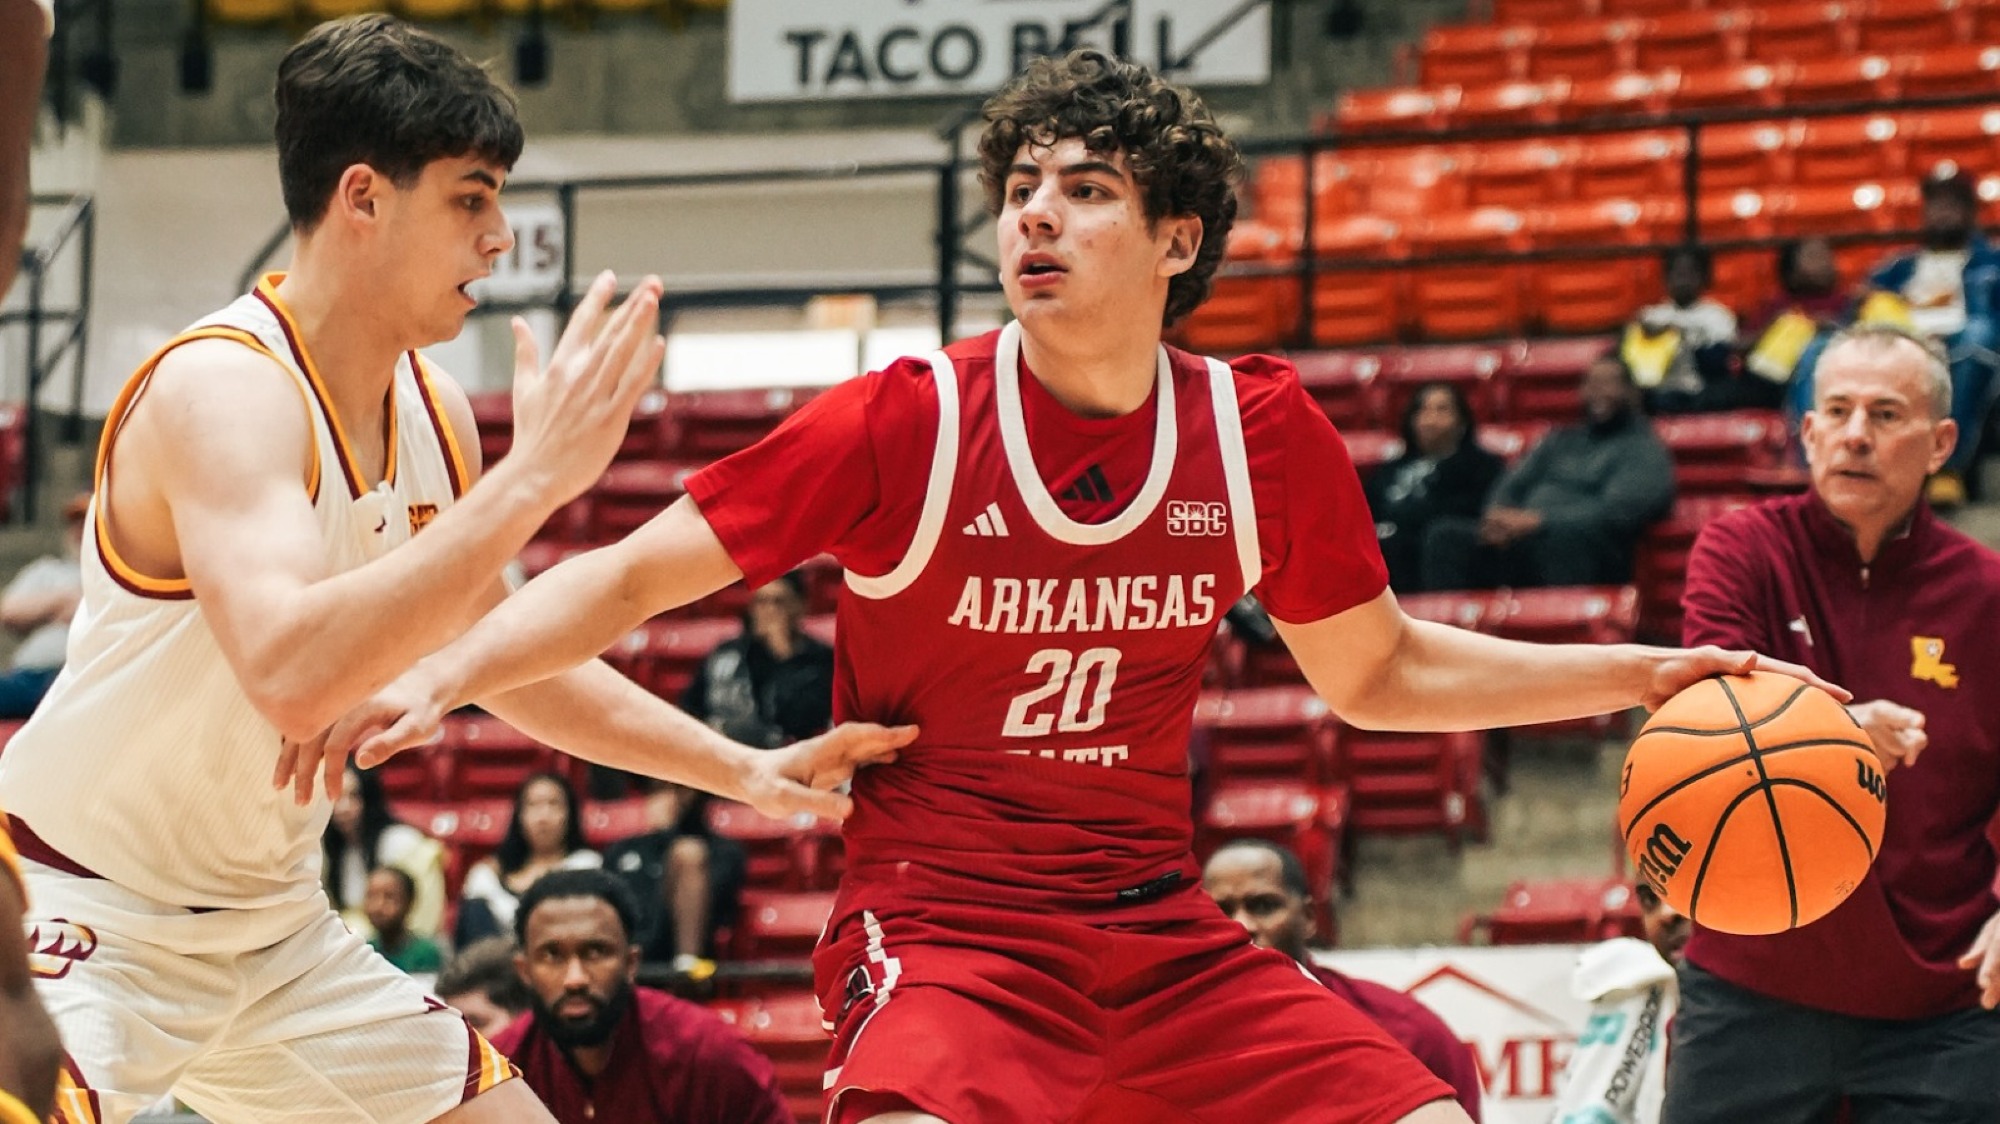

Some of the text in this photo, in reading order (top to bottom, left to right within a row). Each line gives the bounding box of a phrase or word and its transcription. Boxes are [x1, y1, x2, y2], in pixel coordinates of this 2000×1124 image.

[785, 25, 983, 85] TACO
[1166, 500, 1227, 536] SBC
[948, 573, 1216, 634] ARKANSAS
[1001, 647, 1122, 737] 20
